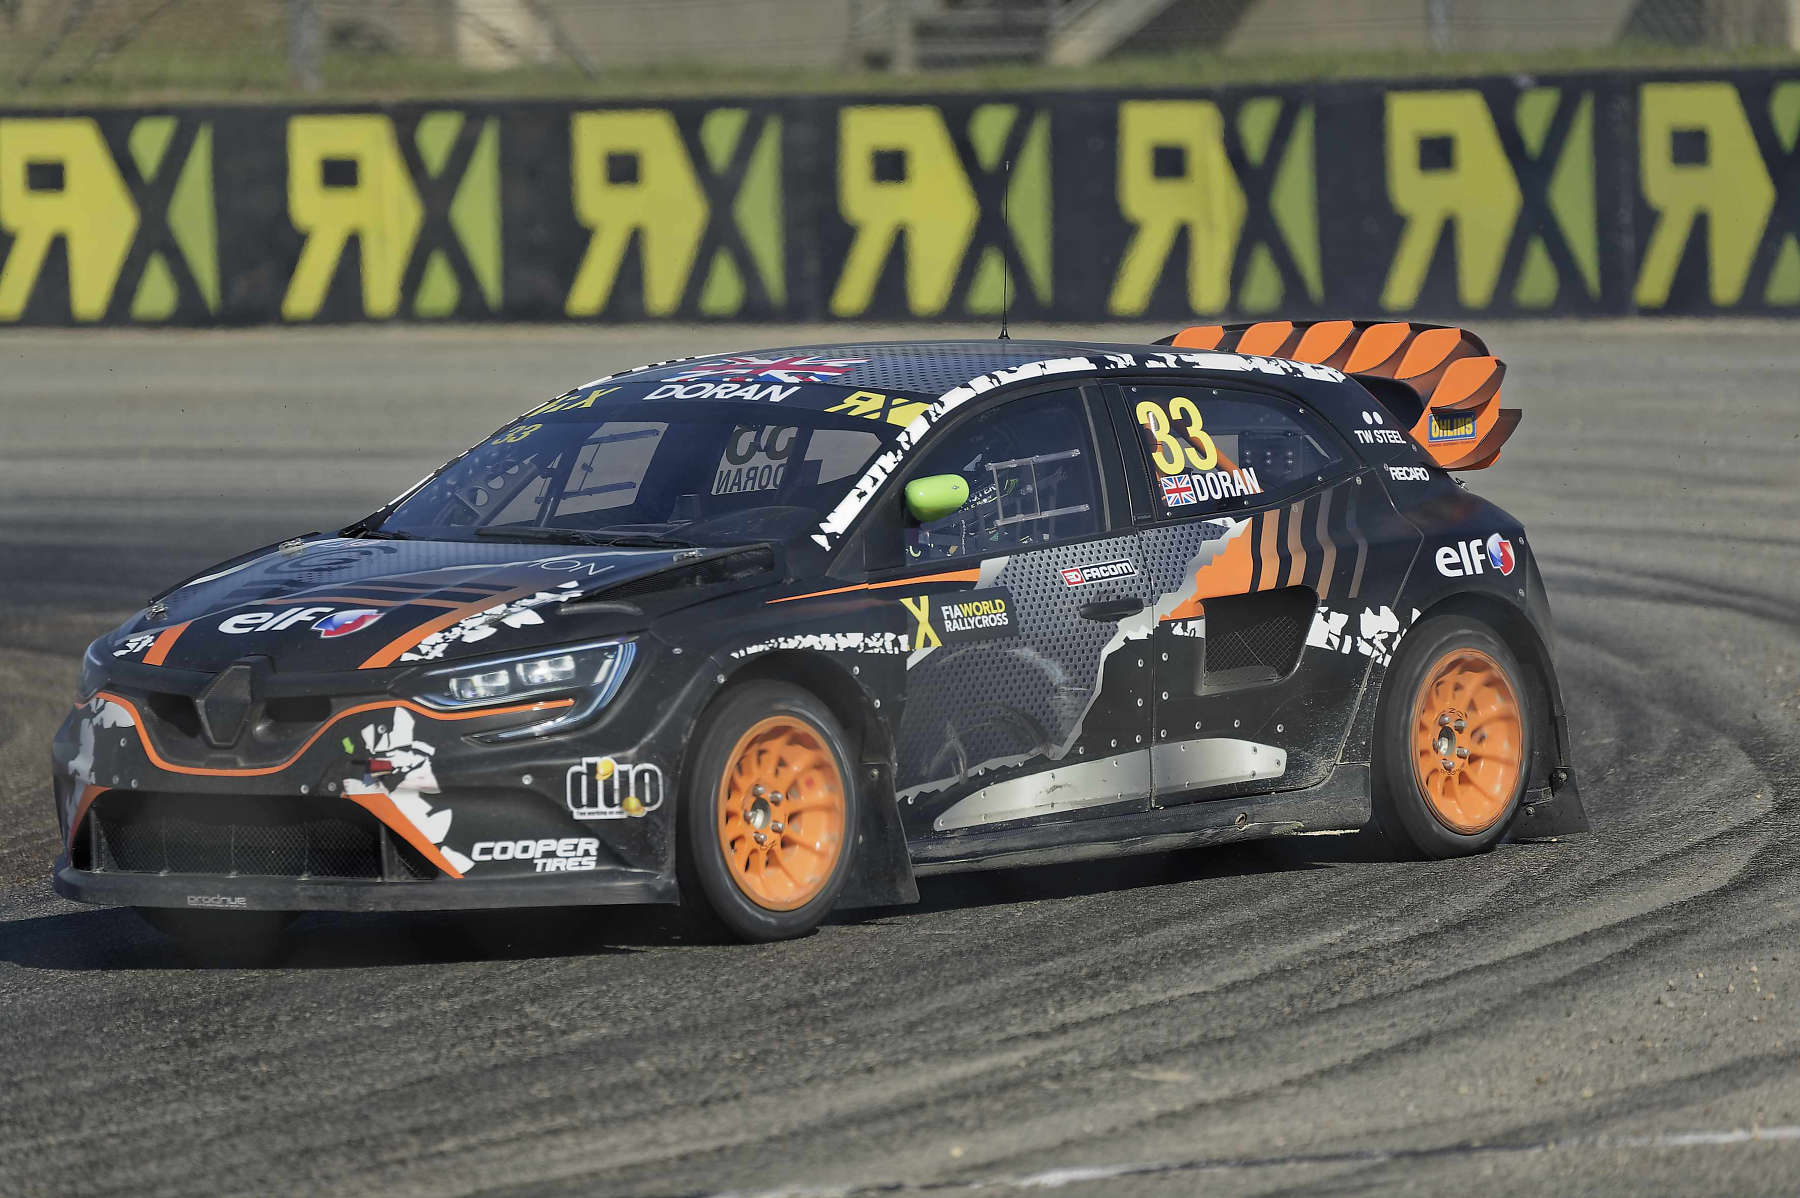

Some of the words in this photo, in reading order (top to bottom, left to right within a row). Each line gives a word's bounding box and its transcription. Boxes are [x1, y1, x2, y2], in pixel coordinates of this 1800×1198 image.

[565, 108, 787, 317] RX
[829, 105, 1053, 316] RX
[1108, 99, 1324, 315] RX
[1380, 87, 1601, 311] RX
[281, 113, 503, 320] RX
[642, 382, 802, 402] DORAN
[1136, 397, 1218, 475] 33
[1354, 430, 1374, 444] TW
[1373, 430, 1407, 444] STEEL
[1191, 467, 1262, 502] DORAN
[1388, 466, 1430, 481] RECARO
[1082, 562, 1134, 581] FACOM
[1435, 539, 1486, 578] elf
[218, 606, 335, 635] elf
[944, 613, 1009, 633] RALLYCROSS
[471, 837, 600, 862] COOPER
[533, 856, 598, 873] TIRES
